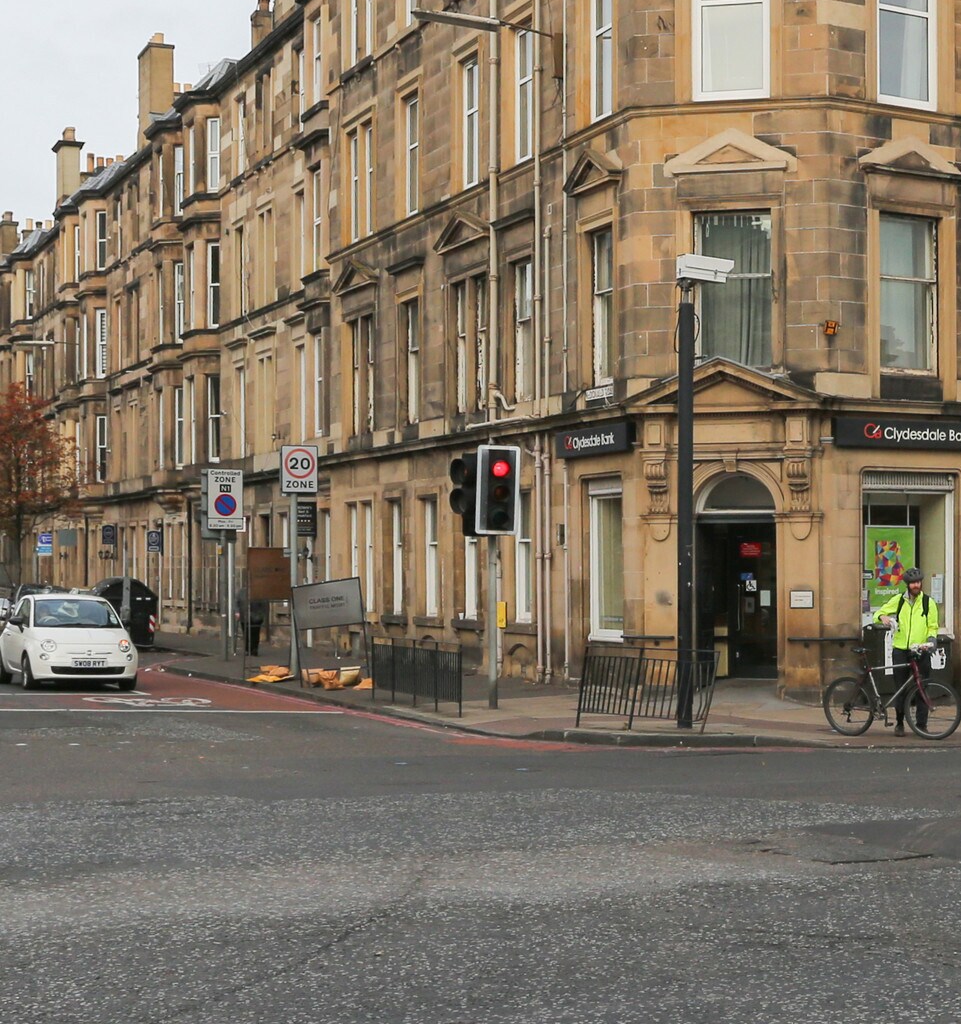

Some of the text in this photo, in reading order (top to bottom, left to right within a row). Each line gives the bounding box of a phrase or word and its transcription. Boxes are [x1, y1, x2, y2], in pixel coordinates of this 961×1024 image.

[573, 434, 600, 451] Clydesdale
[601, 432, 615, 445] Bank
[884, 427, 946, 442] Clydesdale
[289, 457, 310, 470] 20
[286, 480, 314, 489] ZONE
